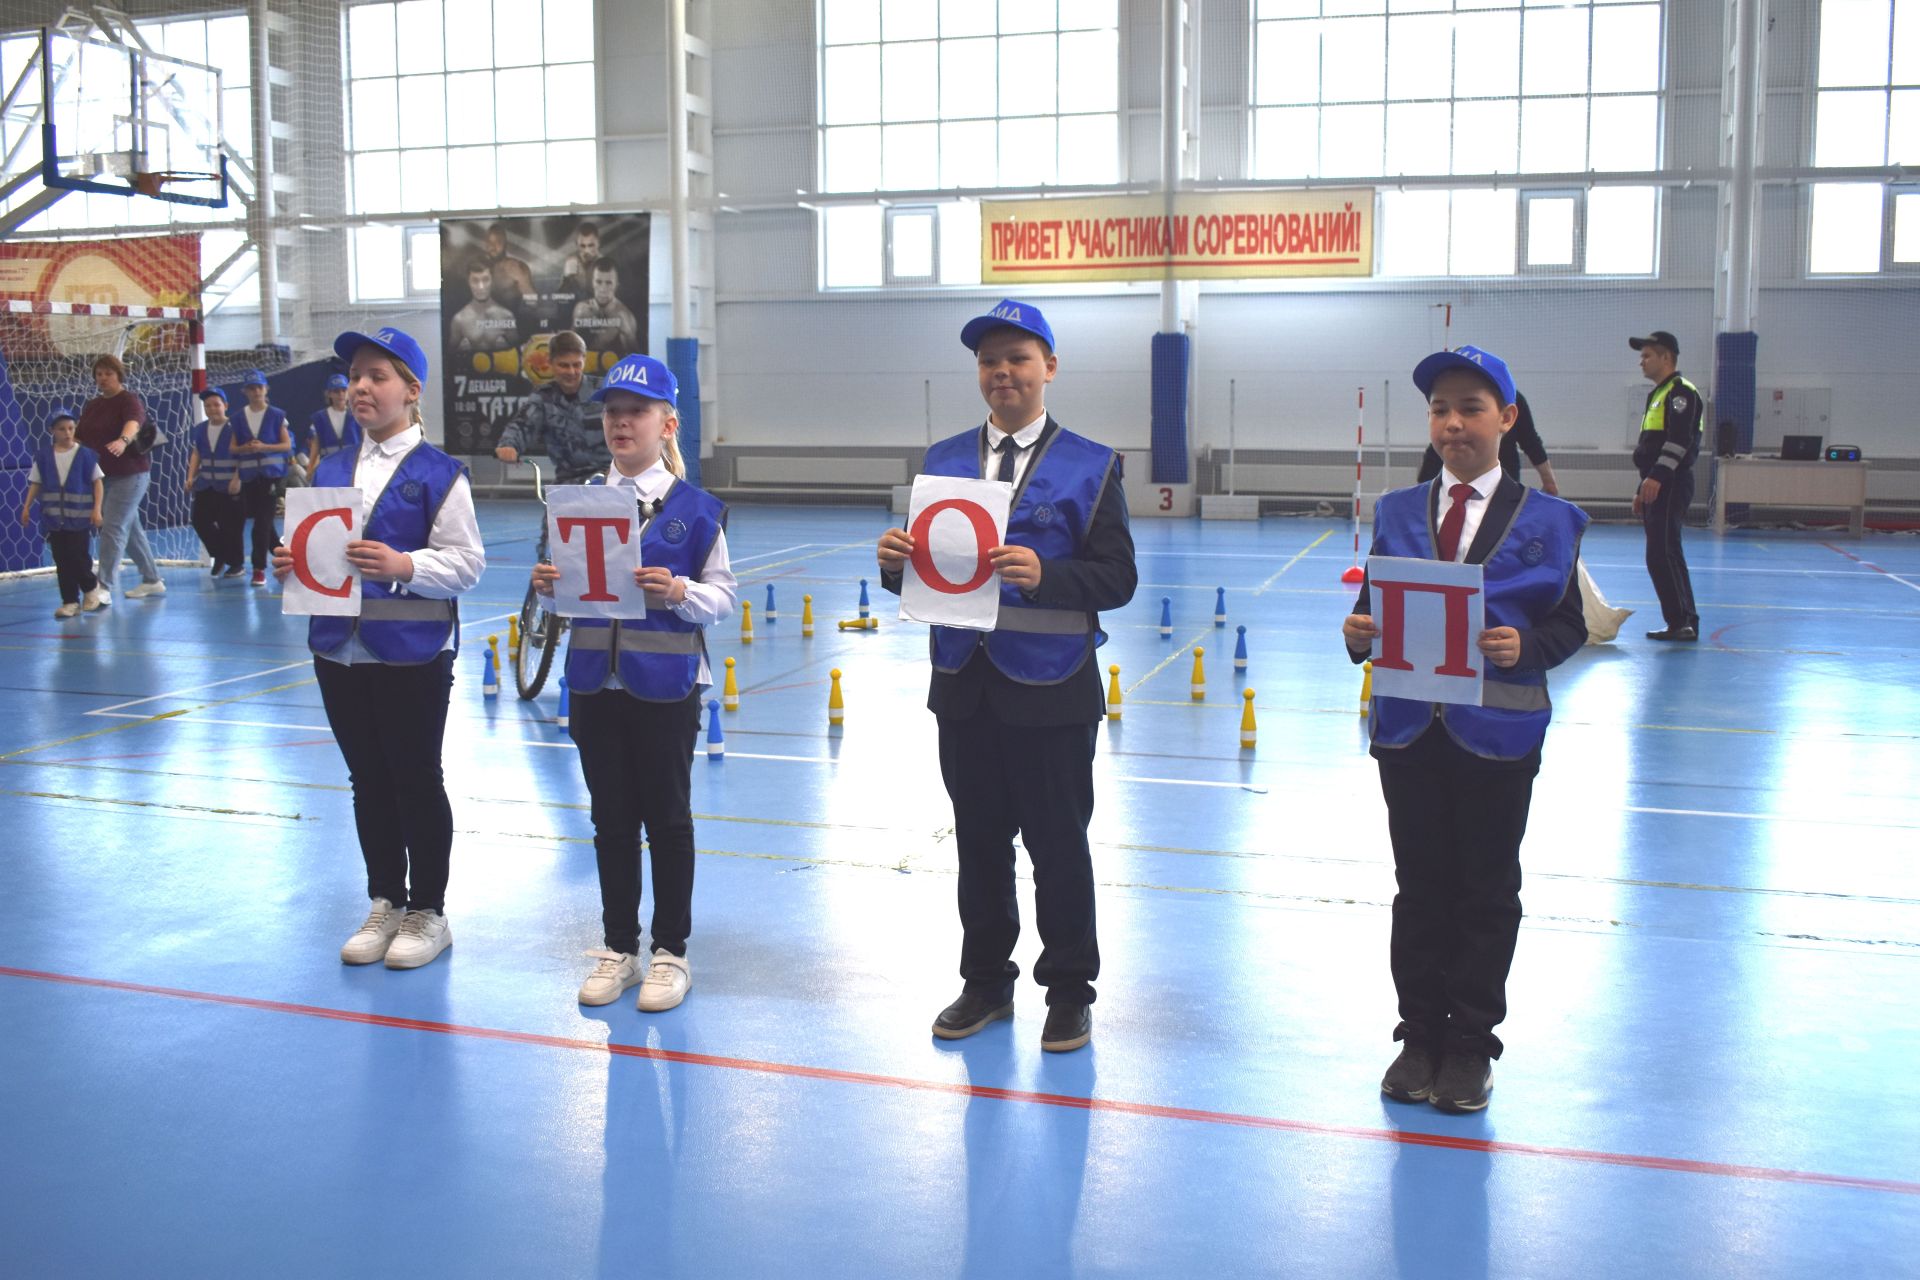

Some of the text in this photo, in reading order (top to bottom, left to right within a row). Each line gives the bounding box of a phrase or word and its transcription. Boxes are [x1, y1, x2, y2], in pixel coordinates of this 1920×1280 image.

[991, 201, 1361, 261] ПРИВЕТ УЧАСТНИКАМ СОРЕВНОВАНИЙ!
[454, 375, 506, 397] 7 ДЕКАБРЯ
[1159, 487, 1173, 511] 3
[290, 508, 354, 598] С
[556, 517, 631, 602] Т
[910, 498, 1000, 595] О
[1370, 579, 1480, 678] П
